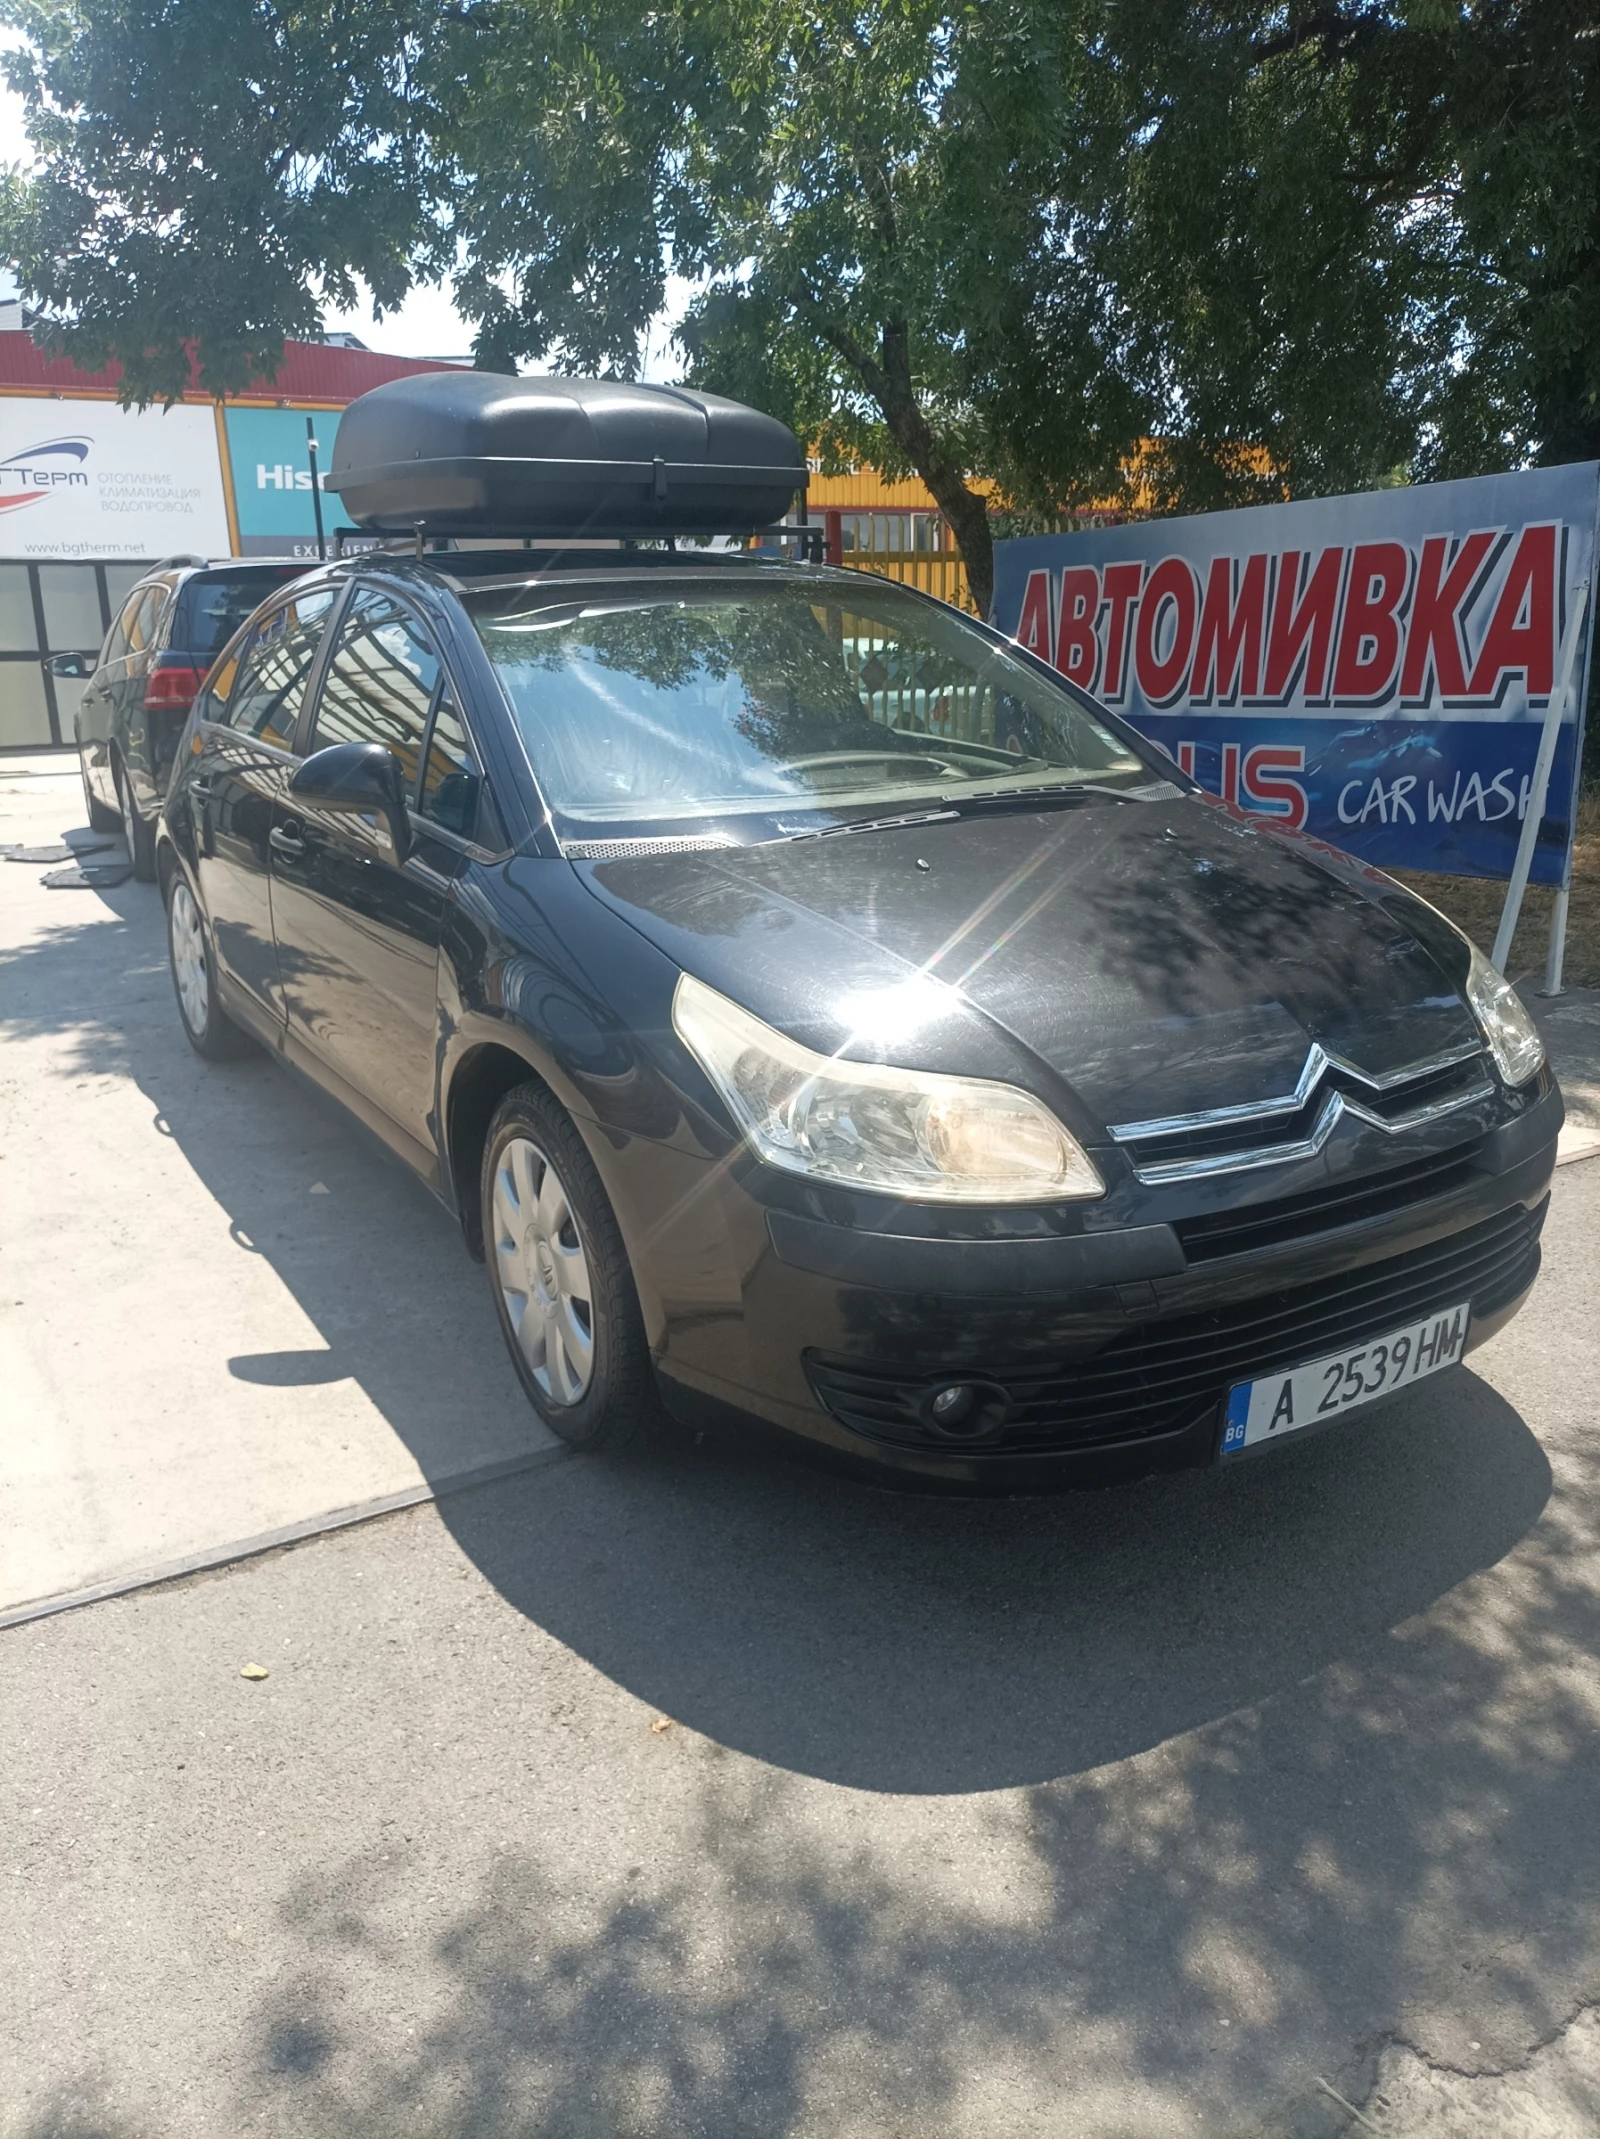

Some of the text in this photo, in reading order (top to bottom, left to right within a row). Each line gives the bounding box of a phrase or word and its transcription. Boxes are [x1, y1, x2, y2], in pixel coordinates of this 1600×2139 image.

[97, 472, 173, 485] ОТОПЛЕНИЕ
[99, 487, 202, 501] КЛИМАТИЗАЦИЯ
[101, 501, 194, 514] ВОДОПРОВОД
[24, 541, 147, 556] www.bgtherm.net
[1016, 518, 1566, 708] АВТОМИВКА
[1337, 774, 1418, 826] CAR
[1269, 1308, 1463, 1430] A 2539 HM
[1225, 1423, 1245, 1443] BG
